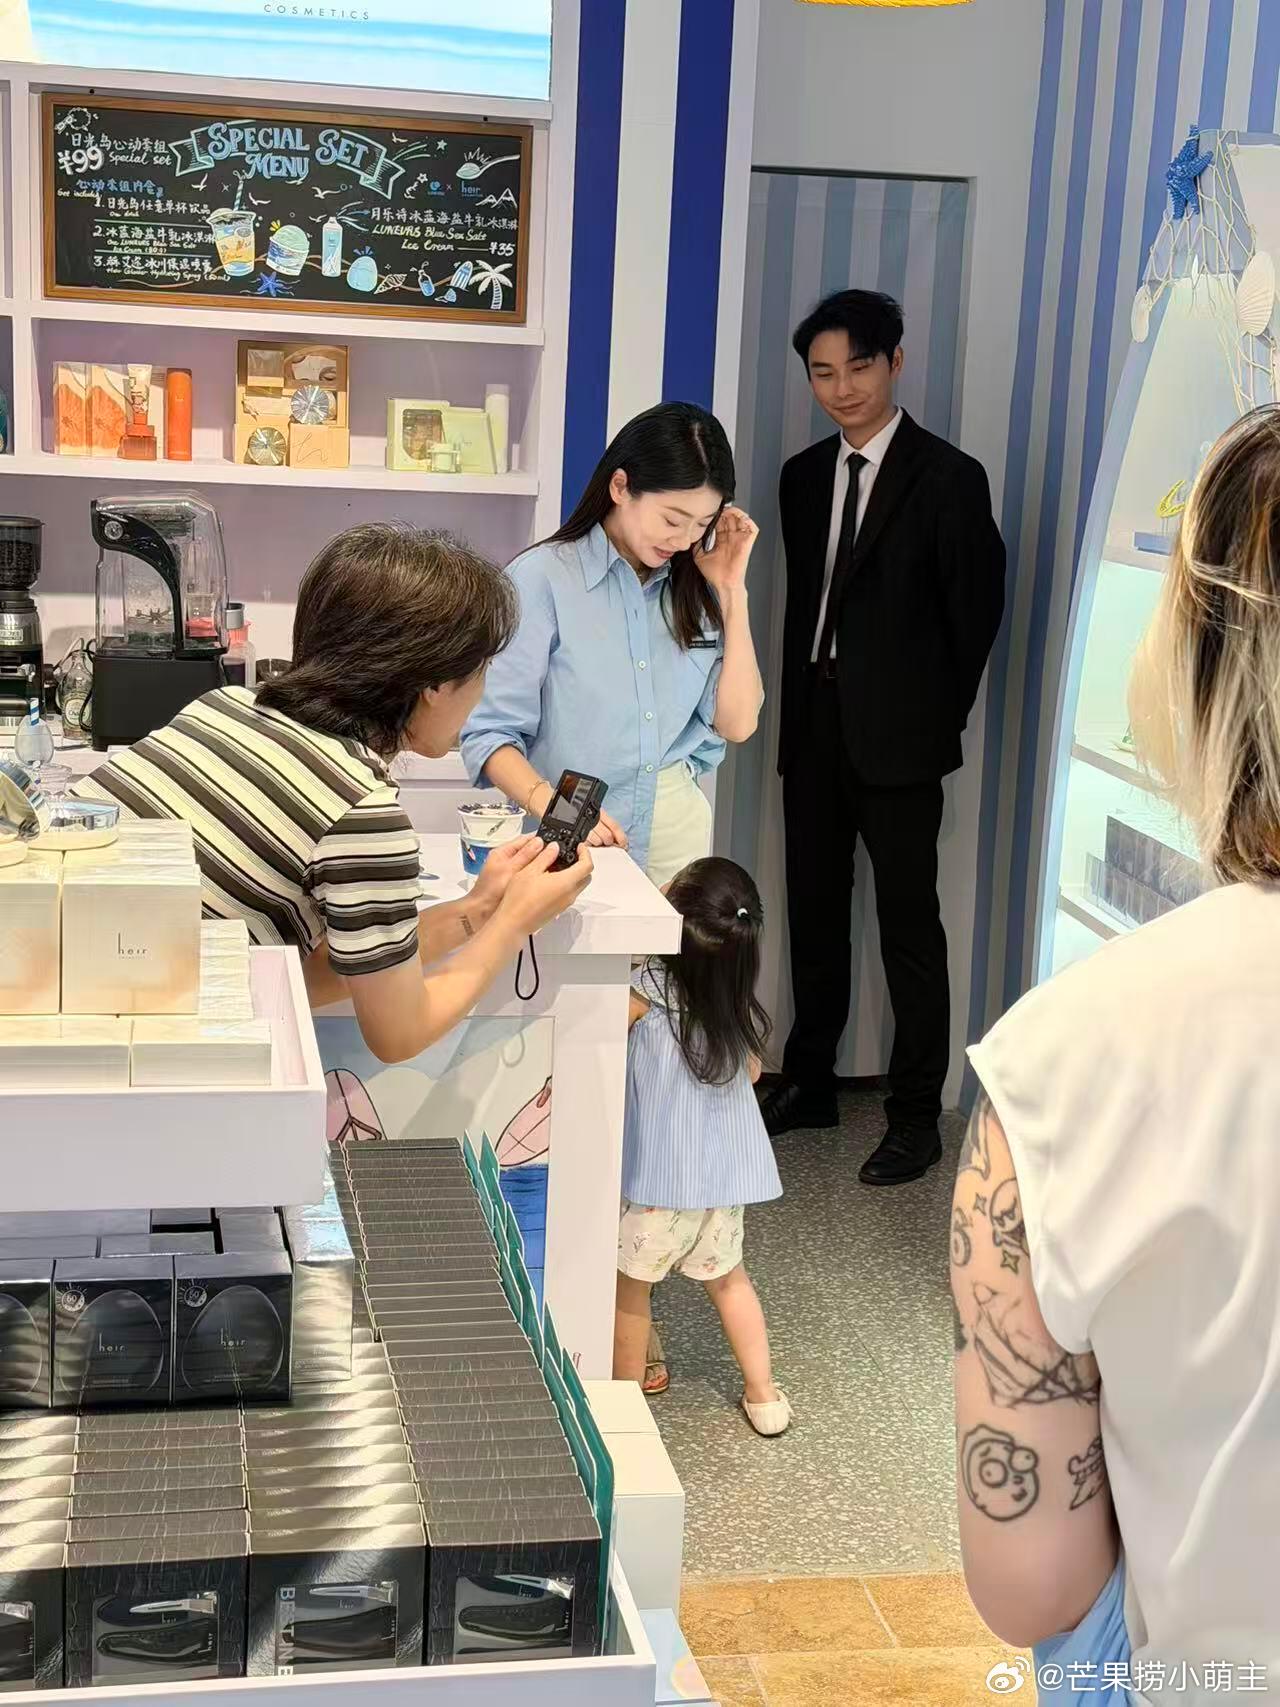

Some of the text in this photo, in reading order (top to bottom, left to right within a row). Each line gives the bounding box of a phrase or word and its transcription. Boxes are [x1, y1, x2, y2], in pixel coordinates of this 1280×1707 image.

[263, 3, 369, 20] COSMETICS
[57, 146, 105, 175] ¥99
[108, 151, 149, 166] Special
[117, 932, 149, 955] heir
[99, 1332, 126, 1352] heir
